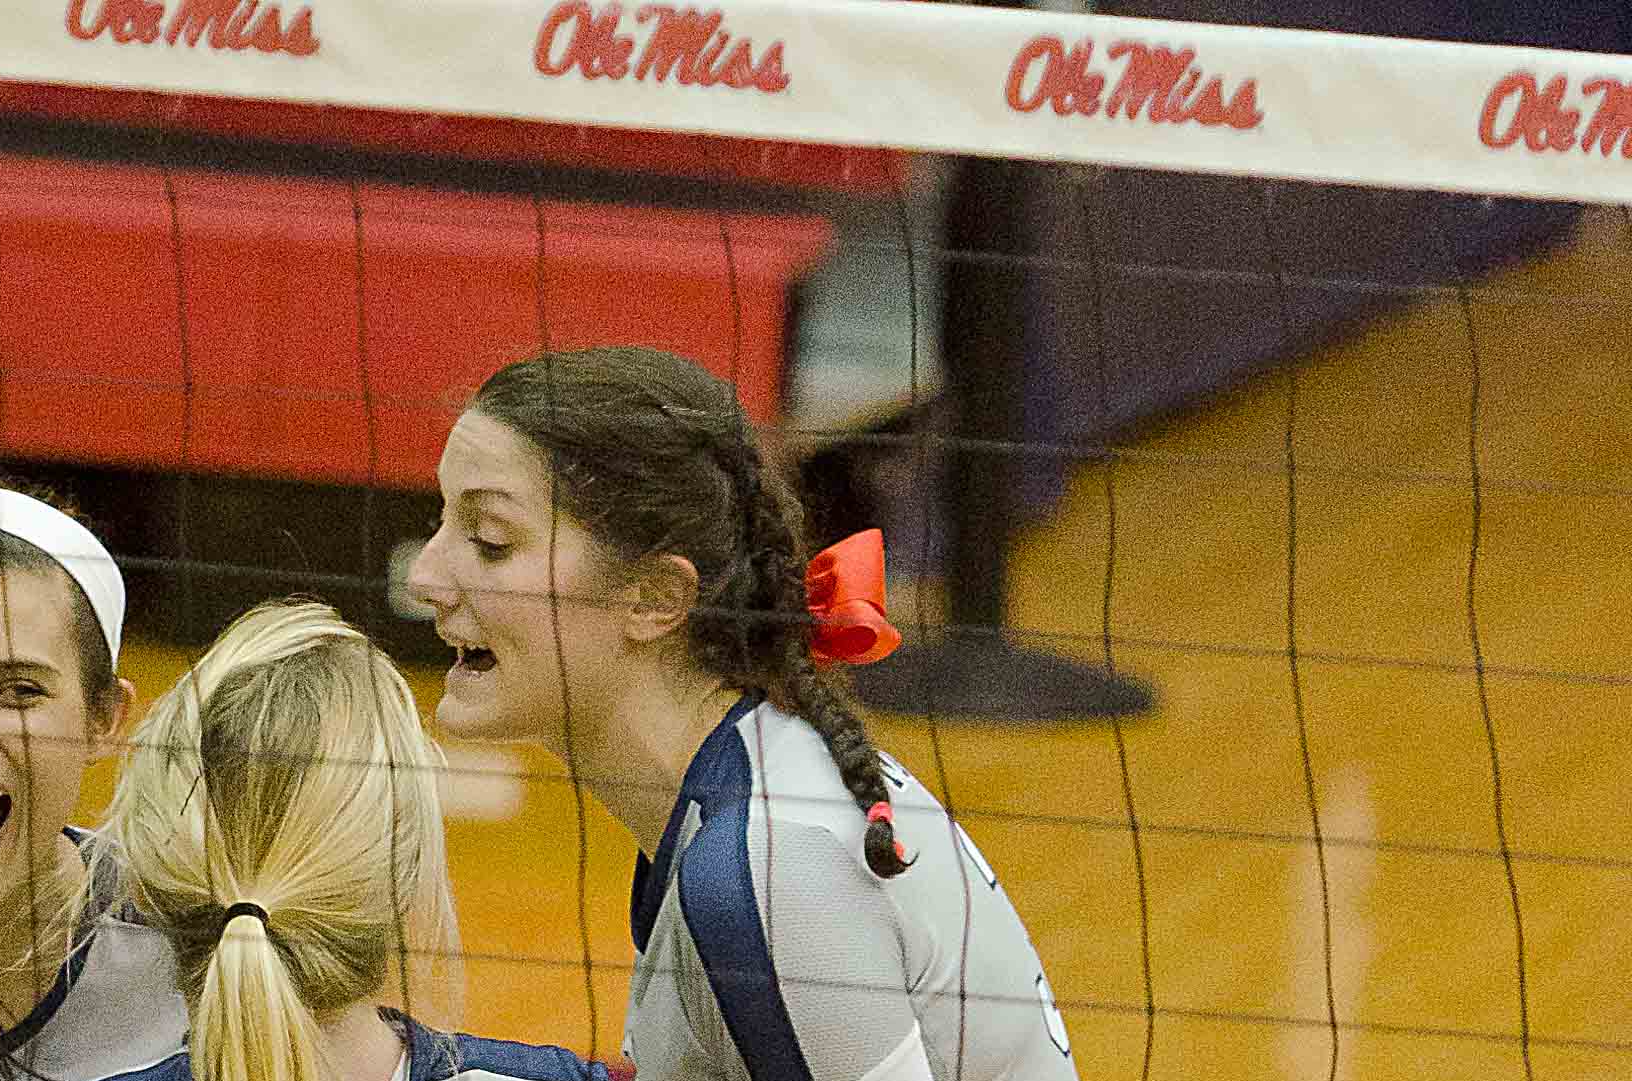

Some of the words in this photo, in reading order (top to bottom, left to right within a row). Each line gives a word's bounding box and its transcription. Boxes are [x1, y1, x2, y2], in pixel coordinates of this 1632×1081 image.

[534, 0, 634, 81] Ole
[634, 4, 792, 93] Miss
[1005, 35, 1104, 116] Ole
[1104, 41, 1260, 129] Miss
[1479, 71, 1580, 153] Ole
